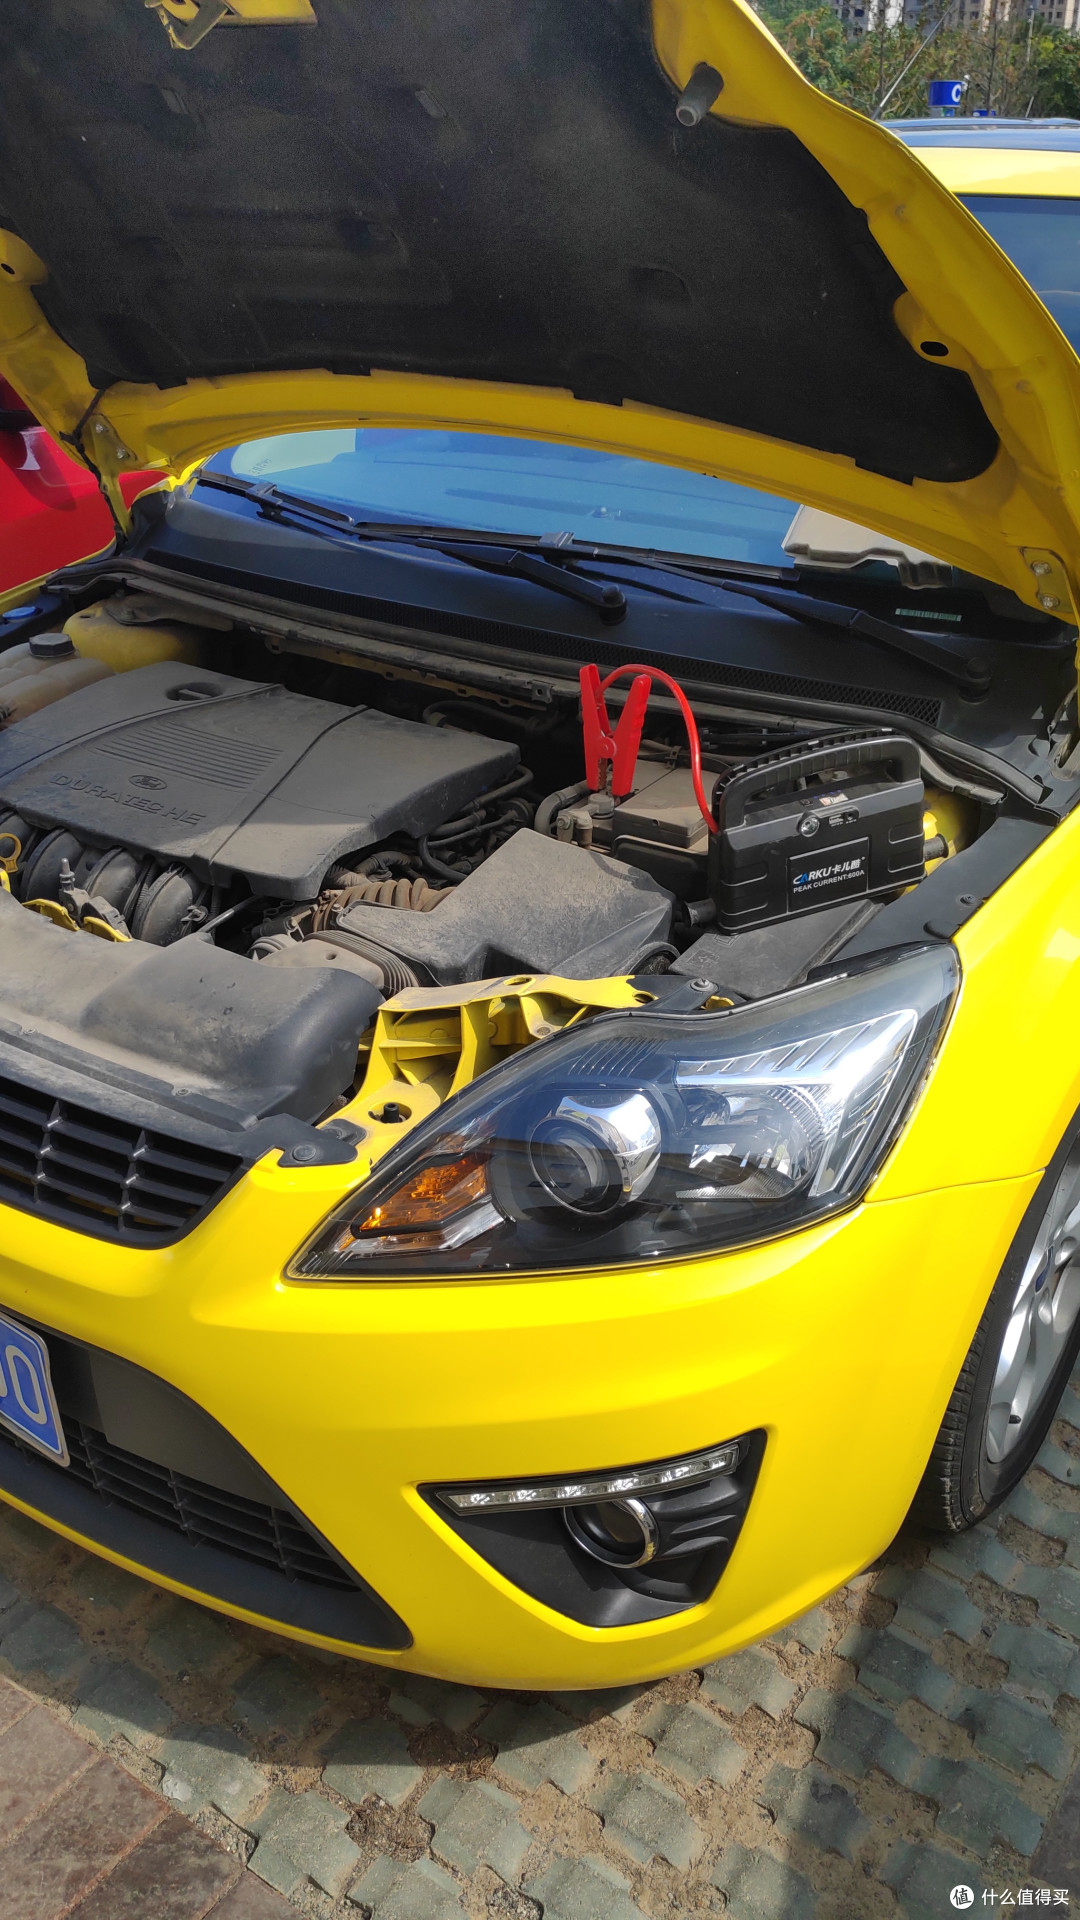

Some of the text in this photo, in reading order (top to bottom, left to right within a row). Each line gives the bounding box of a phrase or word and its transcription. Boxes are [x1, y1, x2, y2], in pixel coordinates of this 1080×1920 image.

[50, 775, 207, 825] DURATEC HE
[793, 884, 812, 893] PEAK
